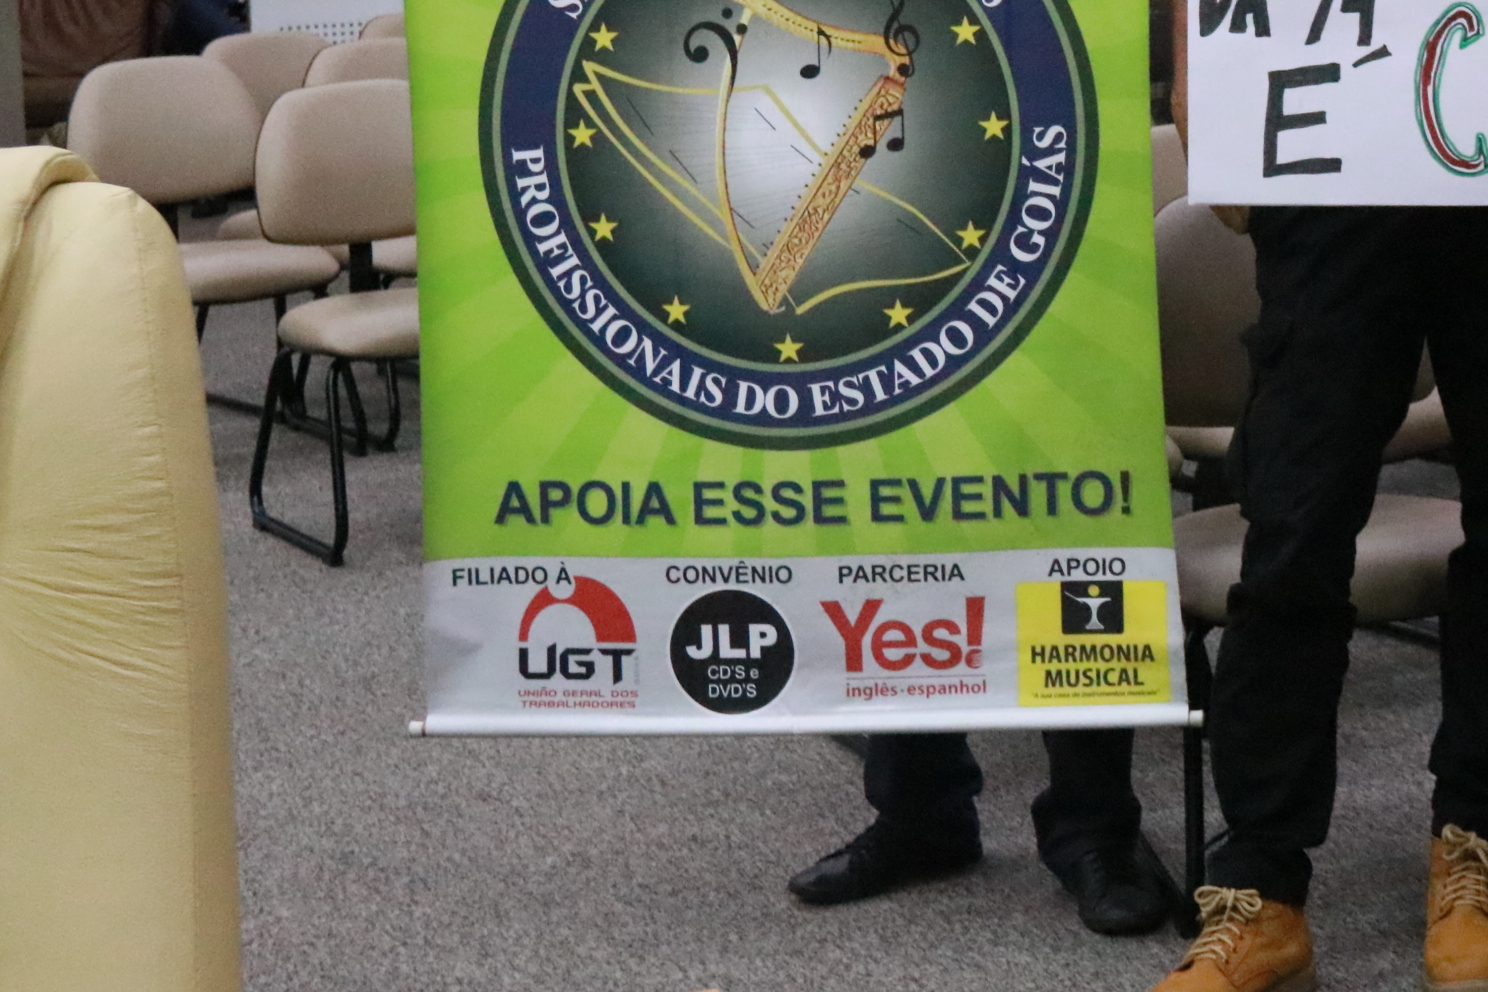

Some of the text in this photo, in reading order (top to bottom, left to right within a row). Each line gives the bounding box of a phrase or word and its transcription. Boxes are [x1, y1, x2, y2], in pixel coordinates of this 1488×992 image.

[511, 125, 1067, 419] PROFISSIONAIS DO ESTADO DE GOIÁS
[494, 470, 1132, 527] APOIA ESSE EVENTO!
[452, 561, 573, 586] FILIADO À
[665, 561, 793, 584] CONVÊNIO
[838, 563, 966, 584] PARCERIA
[1048, 557, 1126, 577] APOIO
[685, 623, 778, 660] JLP
[819, 596, 986, 672] Yes!
[518, 642, 637, 685] UGT
[1031, 644, 1155, 664] HARMONIA
[707, 665, 760, 680] CD'S e
[1044, 668, 1145, 689] MUSICAL
[518, 686, 639, 698] UNIÃO GERAL DOS
[708, 683, 757, 698] DVD'S
[521, 699, 636, 709] TRABALHADORES
